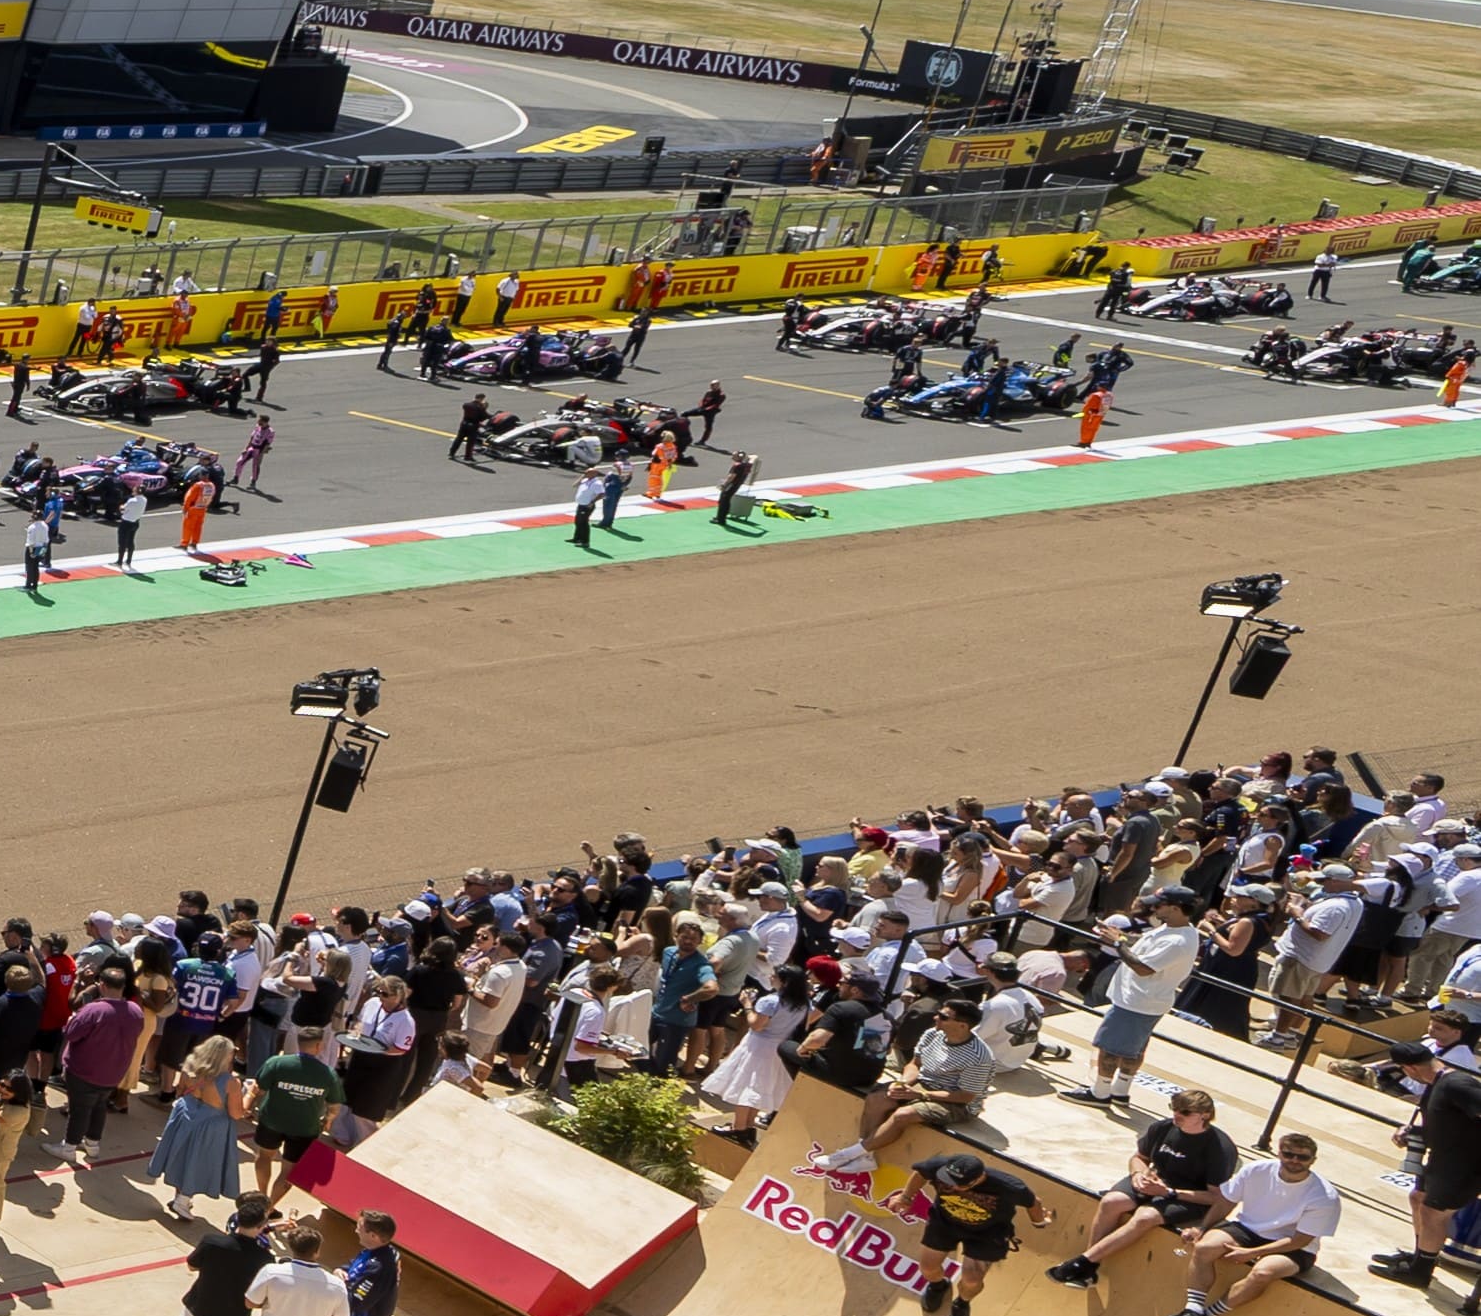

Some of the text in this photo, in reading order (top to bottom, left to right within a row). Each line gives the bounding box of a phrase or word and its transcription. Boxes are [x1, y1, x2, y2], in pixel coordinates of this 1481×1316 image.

[406, 16, 565, 53] QATAR AIRWAYS
[613, 39, 804, 83] QATAR AIRWAYS
[848, 76, 889, 90] Formula
[949, 139, 1015, 163] PIRELLI
[1056, 129, 1114, 151] P ZERO
[89, 204, 135, 224] PIRELLI
[1330, 230, 1372, 252] PIRELLI
[1393, 222, 1440, 244] PIRELLI
[1170, 247, 1222, 270] PIRELLI
[780, 257, 869, 289] PIRELLI
[513, 276, 606, 309] PIRELLI
[187, 974, 224, 986] LAWSON
[179, 981, 221, 1011] 30
[277, 1081, 325, 1096] REPRESENT
[746, 1177, 843, 1254] Red
